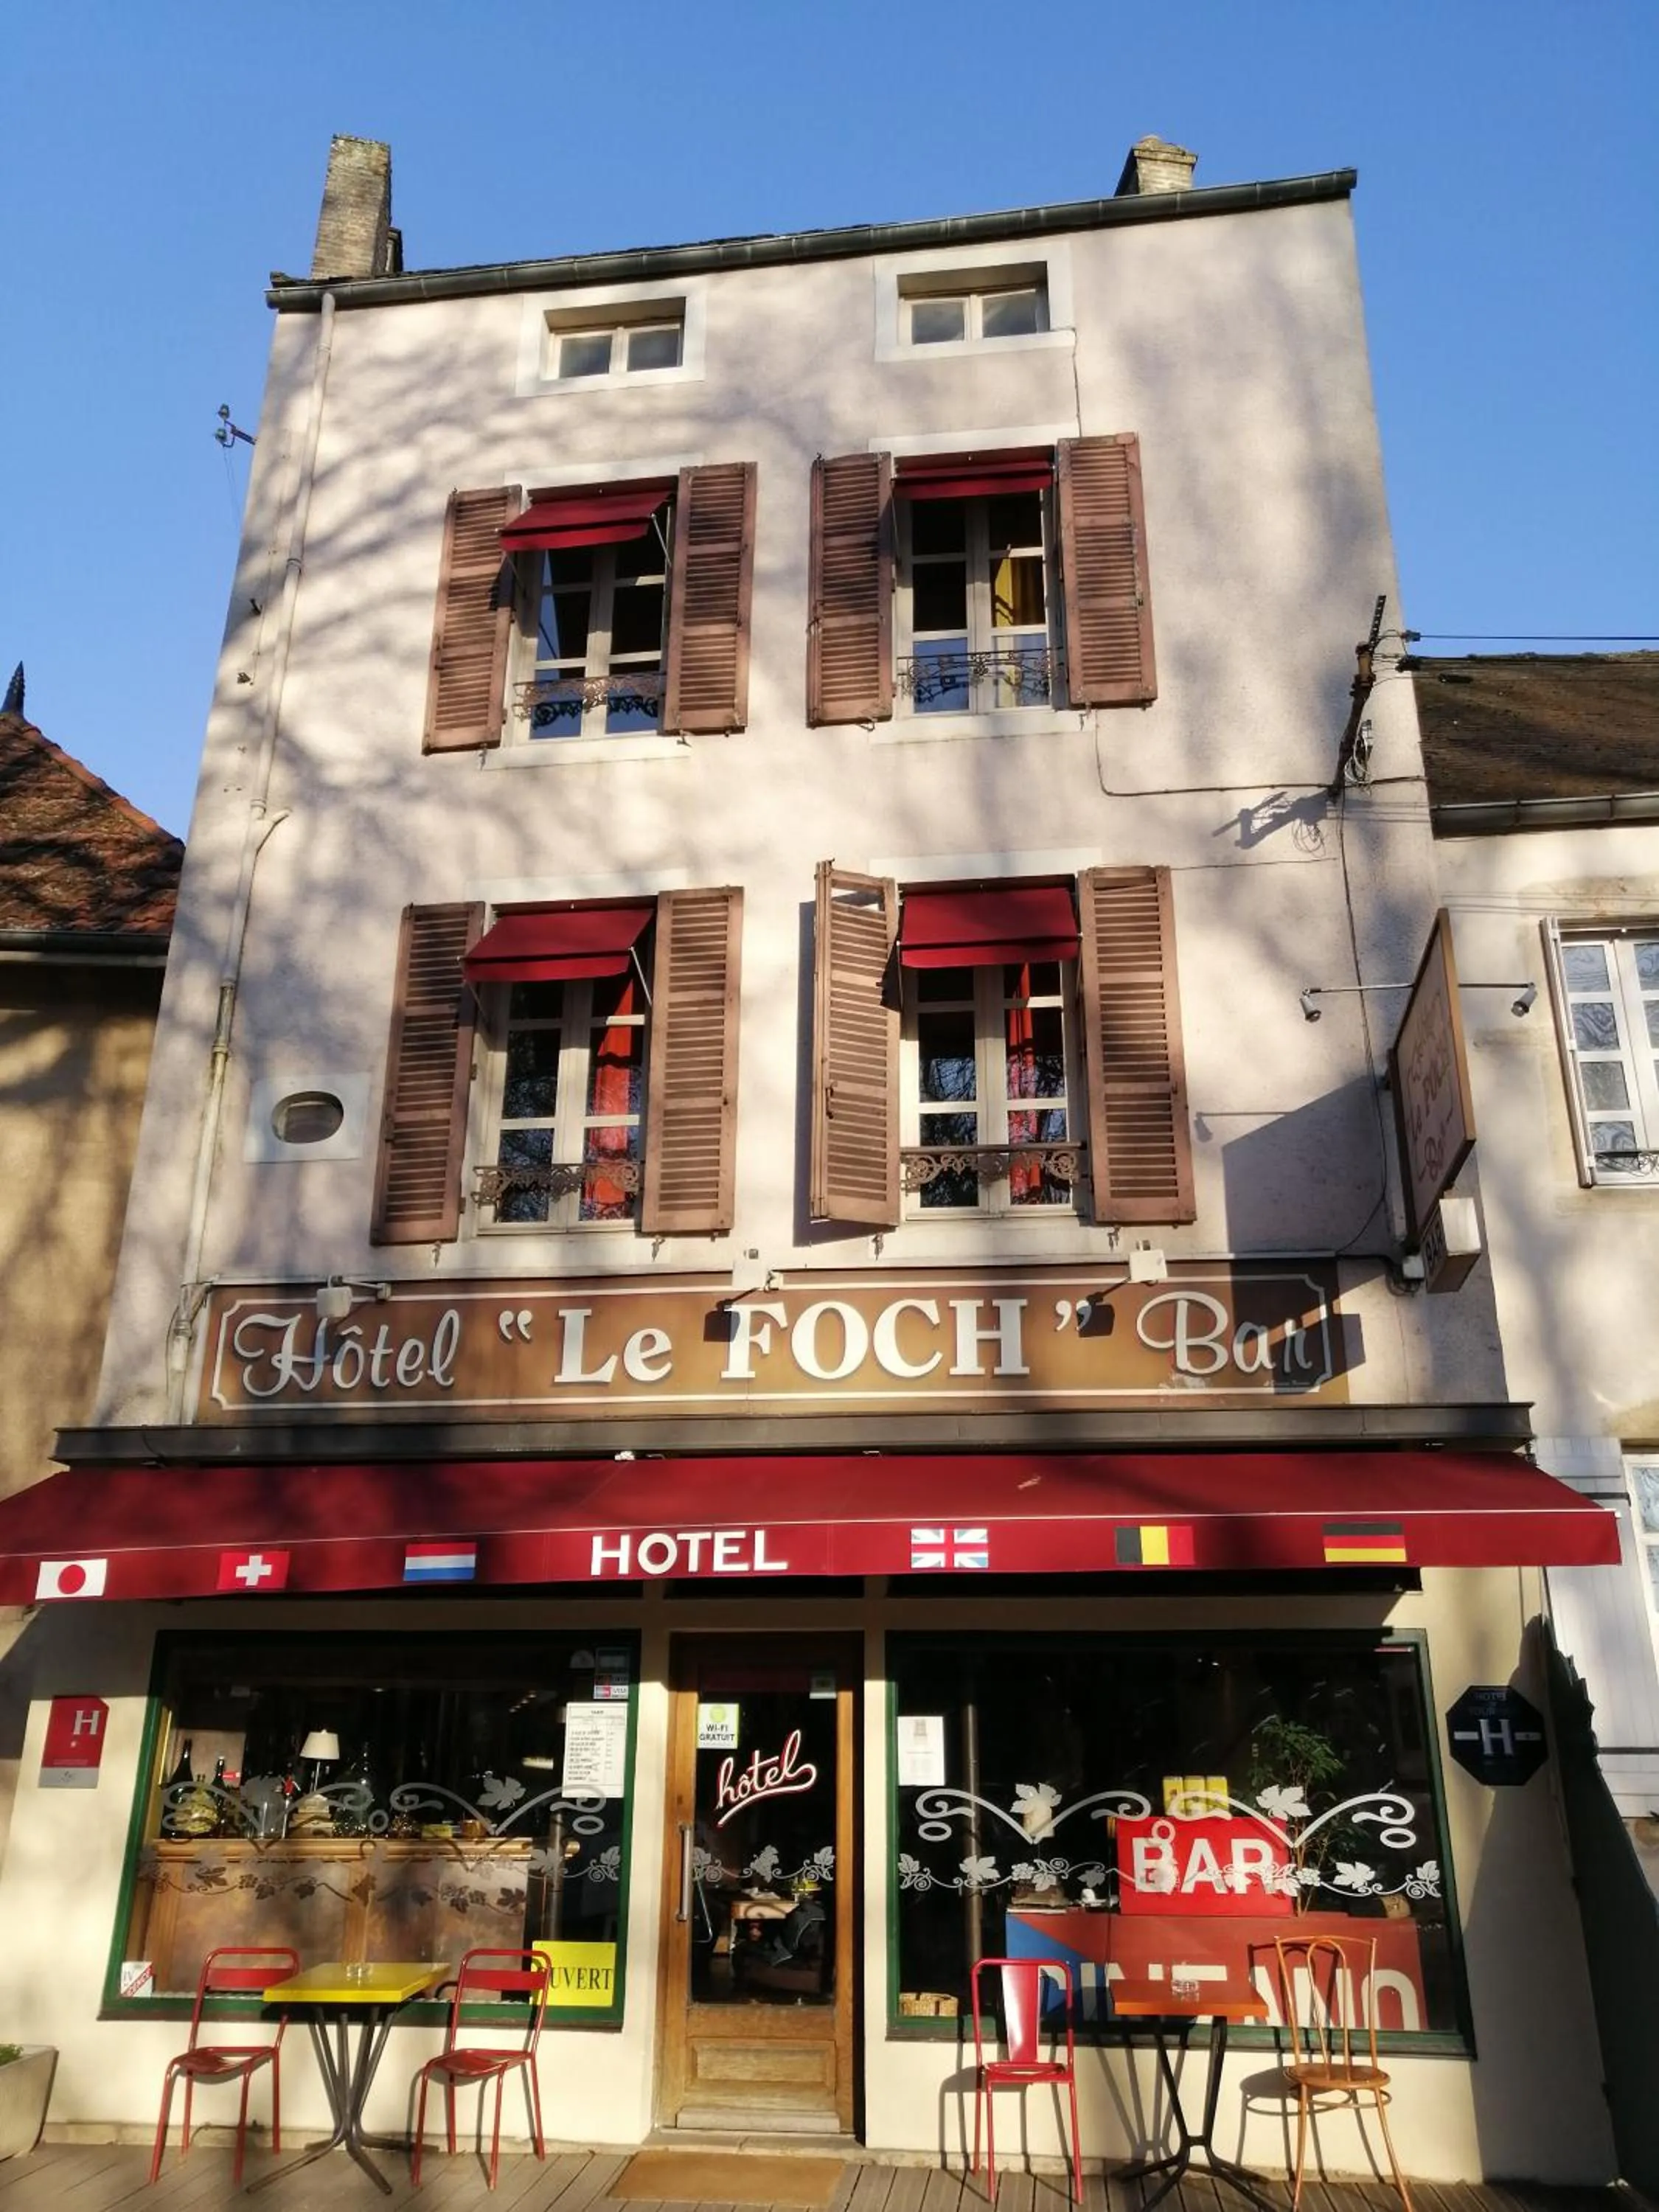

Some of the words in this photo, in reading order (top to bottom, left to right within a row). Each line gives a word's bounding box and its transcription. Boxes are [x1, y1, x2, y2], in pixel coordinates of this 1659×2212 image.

[234, 1308, 462, 1397] Hôtel
[1136, 1290, 1313, 1374] Bar
[591, 1529, 789, 1576] HOTEL
[72, 1710, 100, 1735] H
[699, 1733, 735, 1742] GRATUIT
[706, 1724, 728, 1732] WI-FI
[1476, 1718, 1515, 1756] H
[714, 1728, 818, 1828] hôtel
[1132, 1837, 1275, 1896] BAR
[538, 1966, 613, 1991] UVERT
